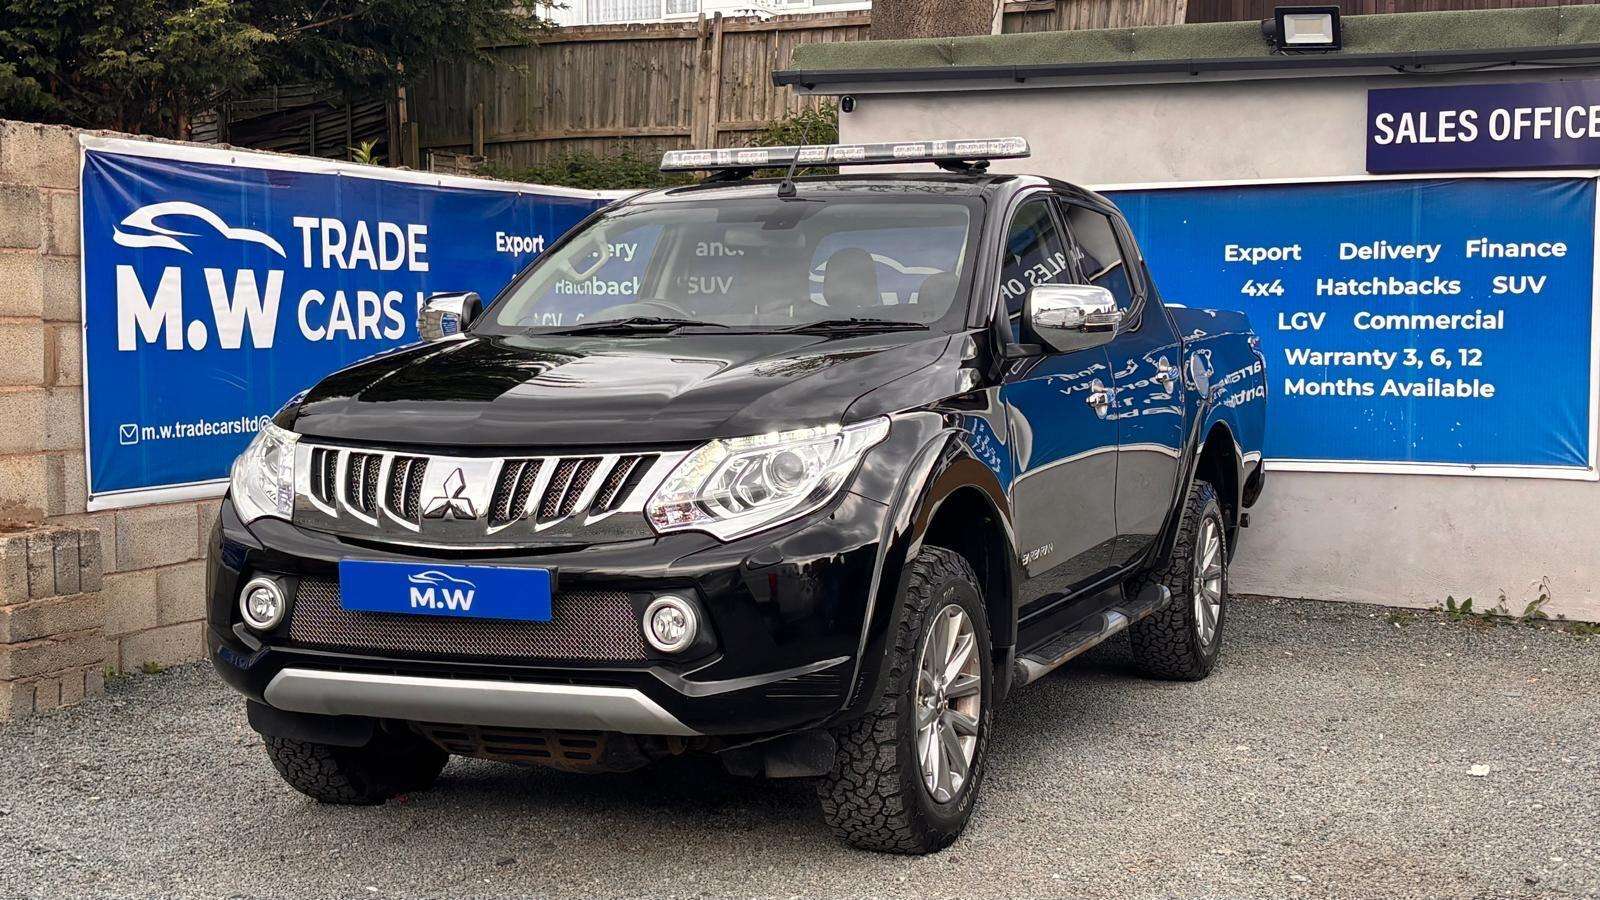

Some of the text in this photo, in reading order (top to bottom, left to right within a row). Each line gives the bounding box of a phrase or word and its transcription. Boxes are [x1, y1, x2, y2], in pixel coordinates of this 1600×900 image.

[1374, 105, 1600, 145] SALES OFFICE
[293, 216, 429, 272] TRADE
[495, 231, 545, 257] Export
[1224, 237, 1567, 265] Export Delivery Finance
[1240, 275, 1547, 297] 4x4 Hatchbacks SUV
[116, 264, 285, 351] M.W
[298, 289, 406, 341] CARS
[1278, 309, 1504, 330] LGV Commercial
[1284, 348, 1483, 370] Warranty 3, 6, 12
[1284, 378, 1375, 396] Months
[1380, 377, 1495, 398] Available
[410, 587, 475, 611] M.W
